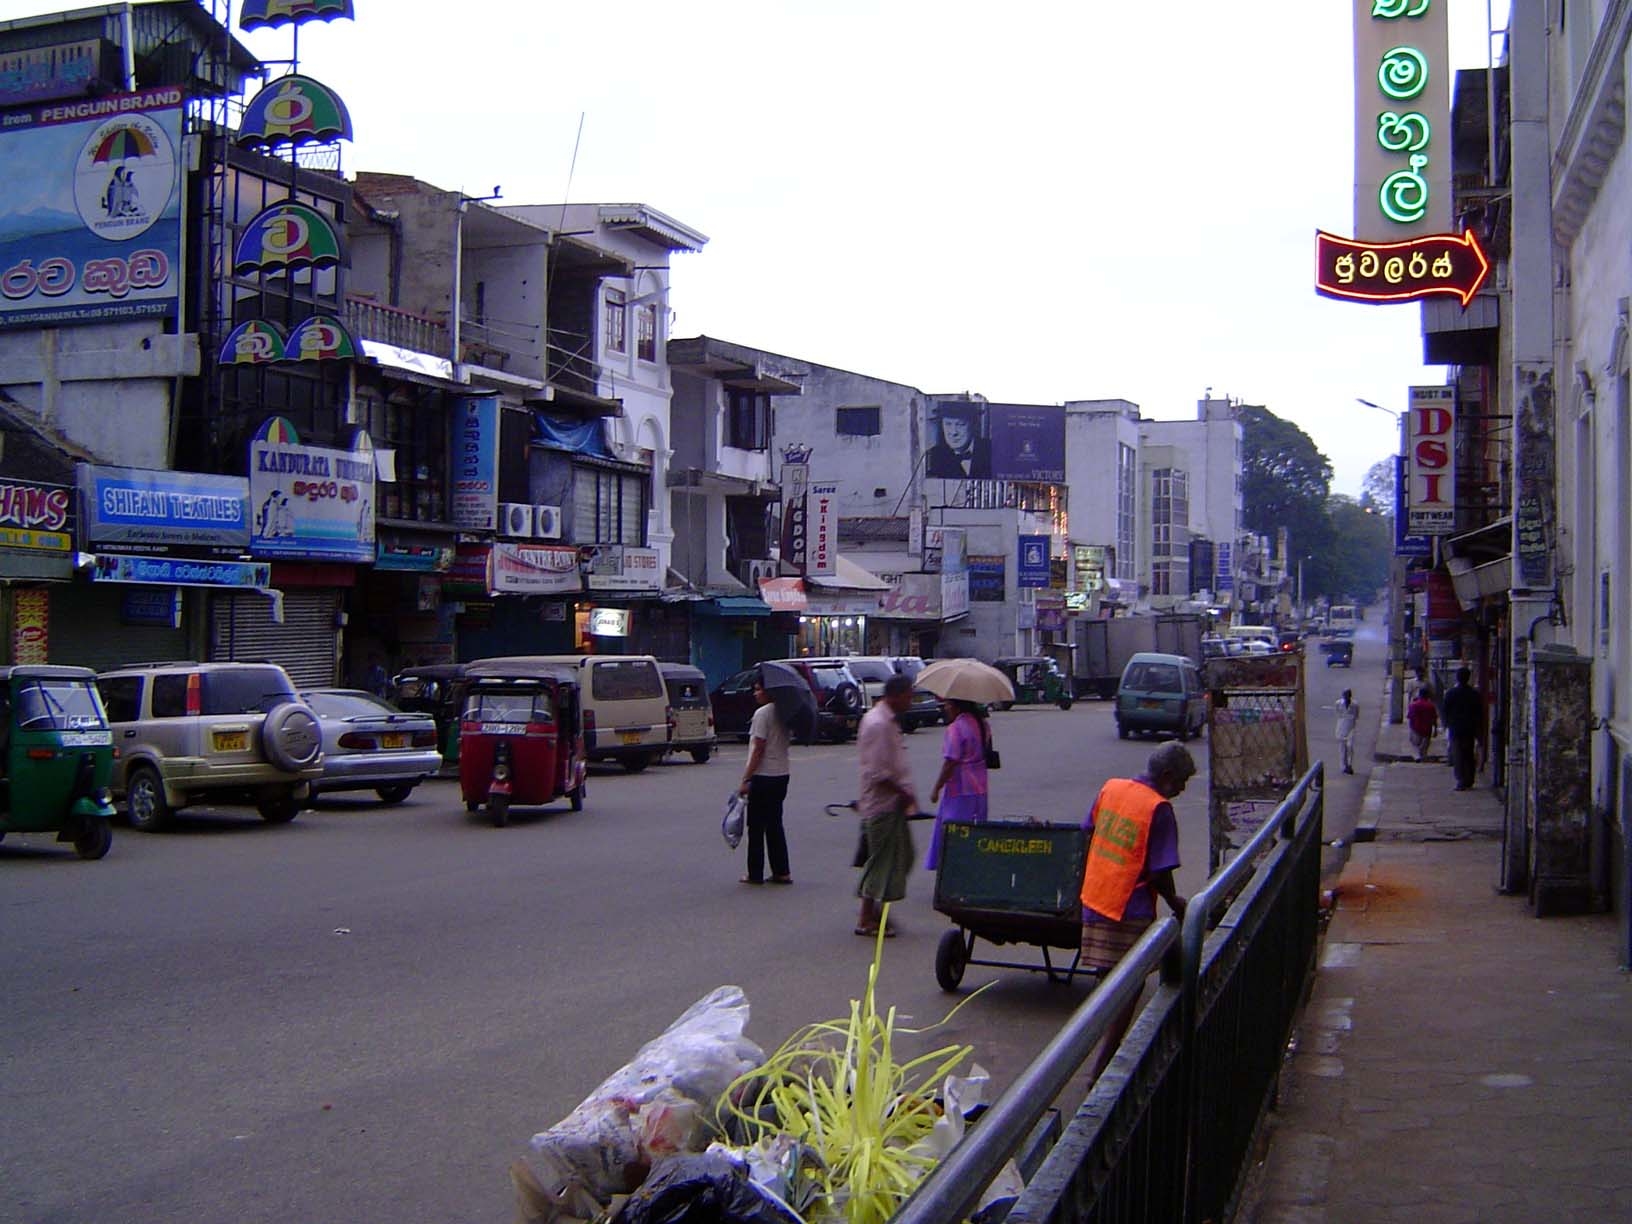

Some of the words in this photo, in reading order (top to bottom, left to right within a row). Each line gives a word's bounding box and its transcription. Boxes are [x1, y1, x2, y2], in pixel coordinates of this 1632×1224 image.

[3, 113, 32, 126] from
[41, 98, 119, 122] PENGUIN
[120, 90, 182, 112] BRAND
[257, 450, 331, 478] KANDURATA
[1413, 407, 1453, 504] DSI
[103, 487, 168, 519] SHIFANI
[170, 492, 242, 523] TEXTILES
[812, 486, 836, 495] Saree
[791, 468, 805, 564] KINGDOM
[1410, 510, 1454, 521] FOOTWEAR
[816, 504, 828, 569] Kingdom
